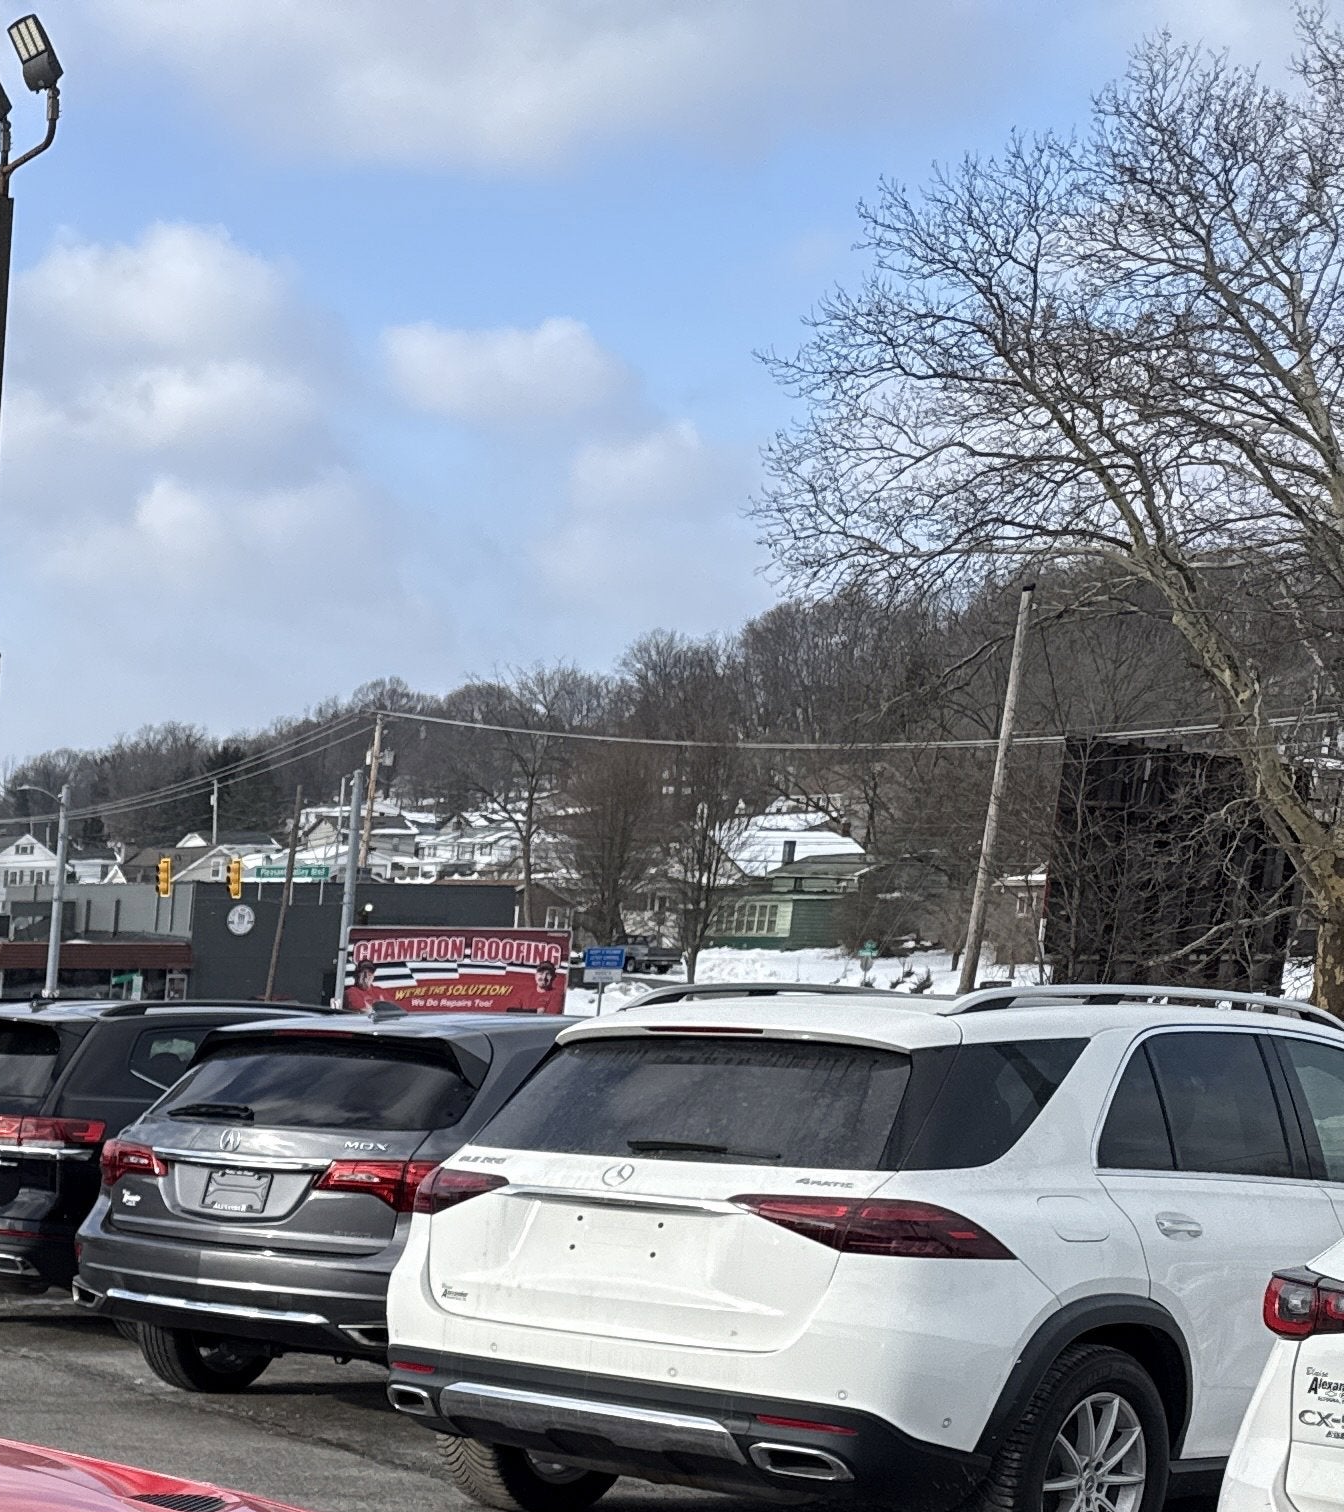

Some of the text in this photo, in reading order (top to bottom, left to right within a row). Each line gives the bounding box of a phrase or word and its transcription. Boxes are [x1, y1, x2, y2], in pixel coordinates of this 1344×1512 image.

[353, 937, 465, 965] CHAMPION
[471, 938, 562, 966] ROOFING
[395, 986, 426, 1001] WE'RE
[446, 984, 514, 997] SOLUTION!
[411, 999, 425, 1008] We
[426, 999, 438, 1008] Do
[440, 999, 472, 1009] Repairs
[344, 1140, 389, 1151] MDX
[1307, 1376, 1344, 1395] Alexan
[1298, 1409, 1344, 1429] CX-
